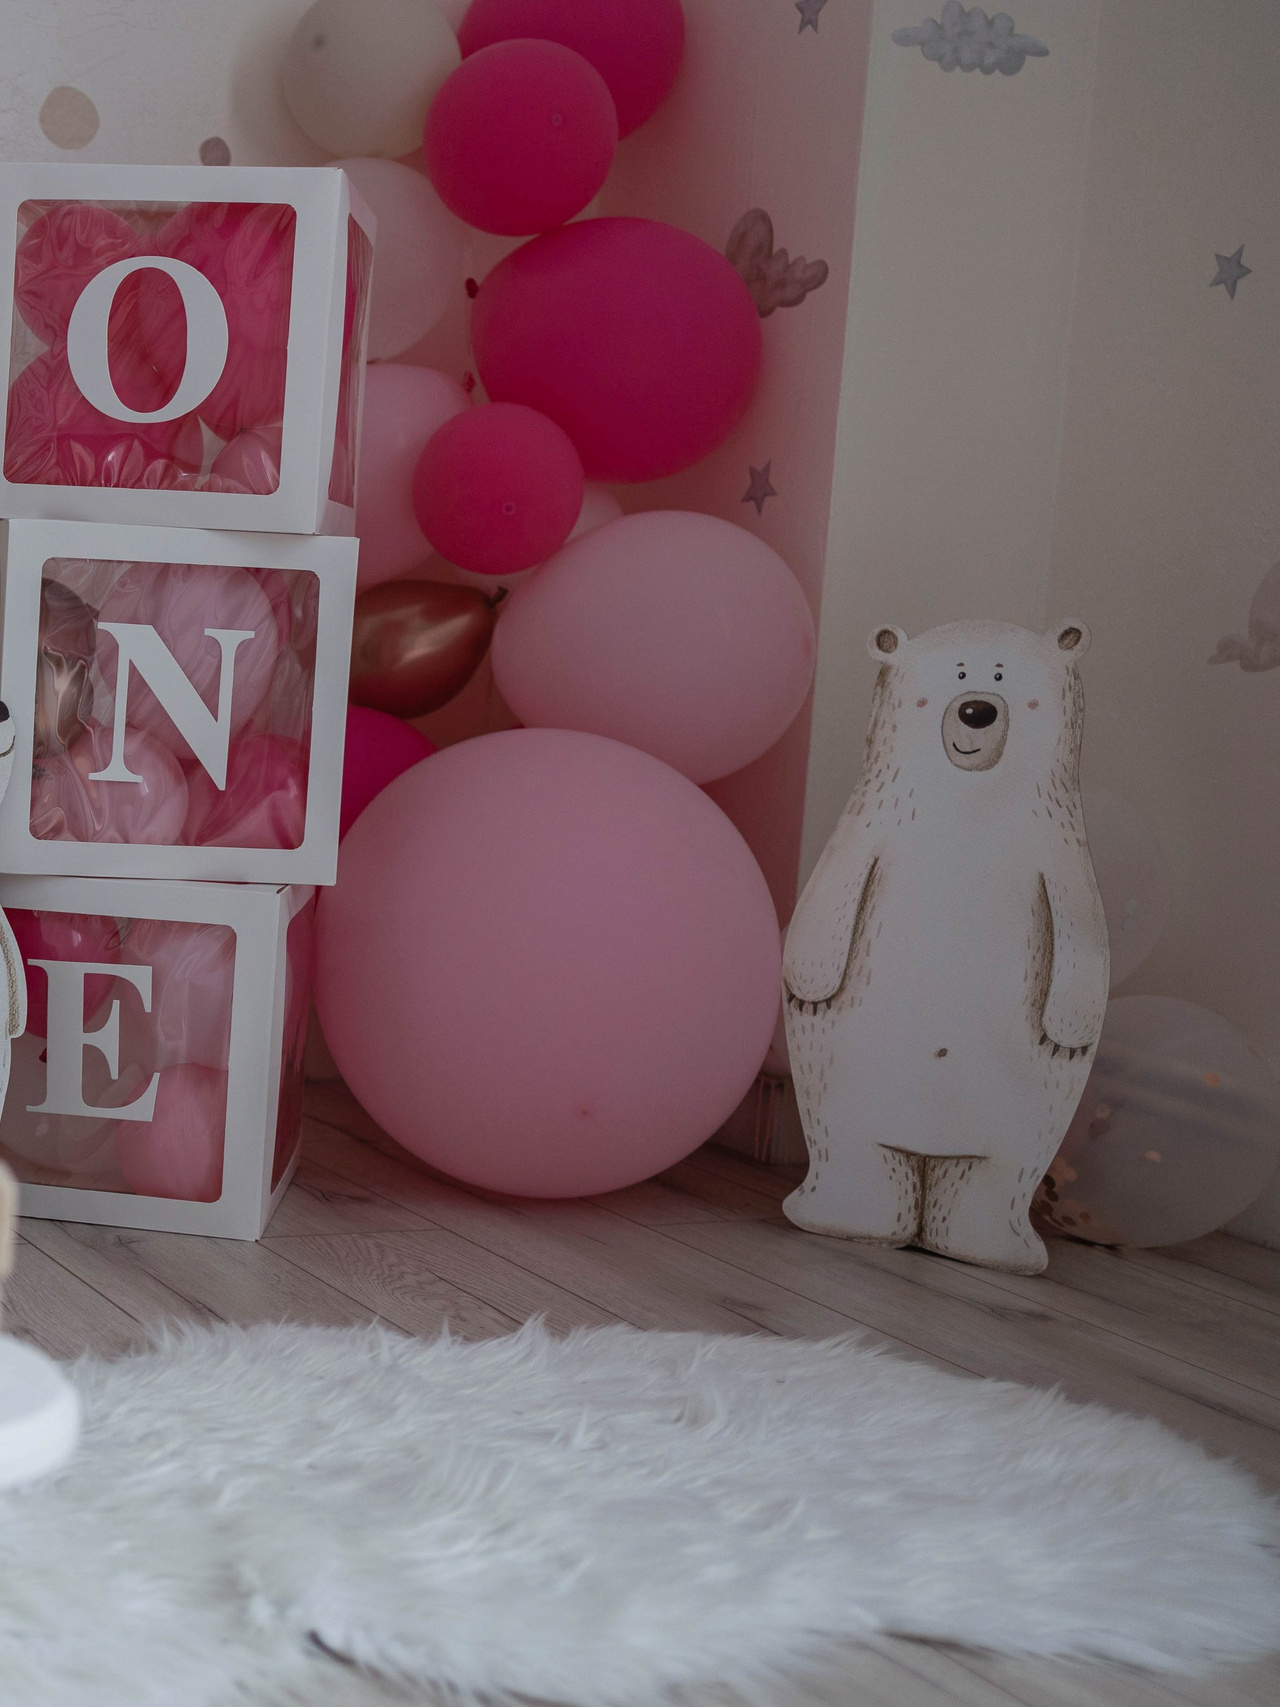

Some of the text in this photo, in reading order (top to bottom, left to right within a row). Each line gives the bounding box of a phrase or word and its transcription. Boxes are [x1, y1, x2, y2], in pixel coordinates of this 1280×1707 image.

[67, 255, 229, 423] O
[88, 621, 255, 791] N
[26, 958, 161, 1123] E
